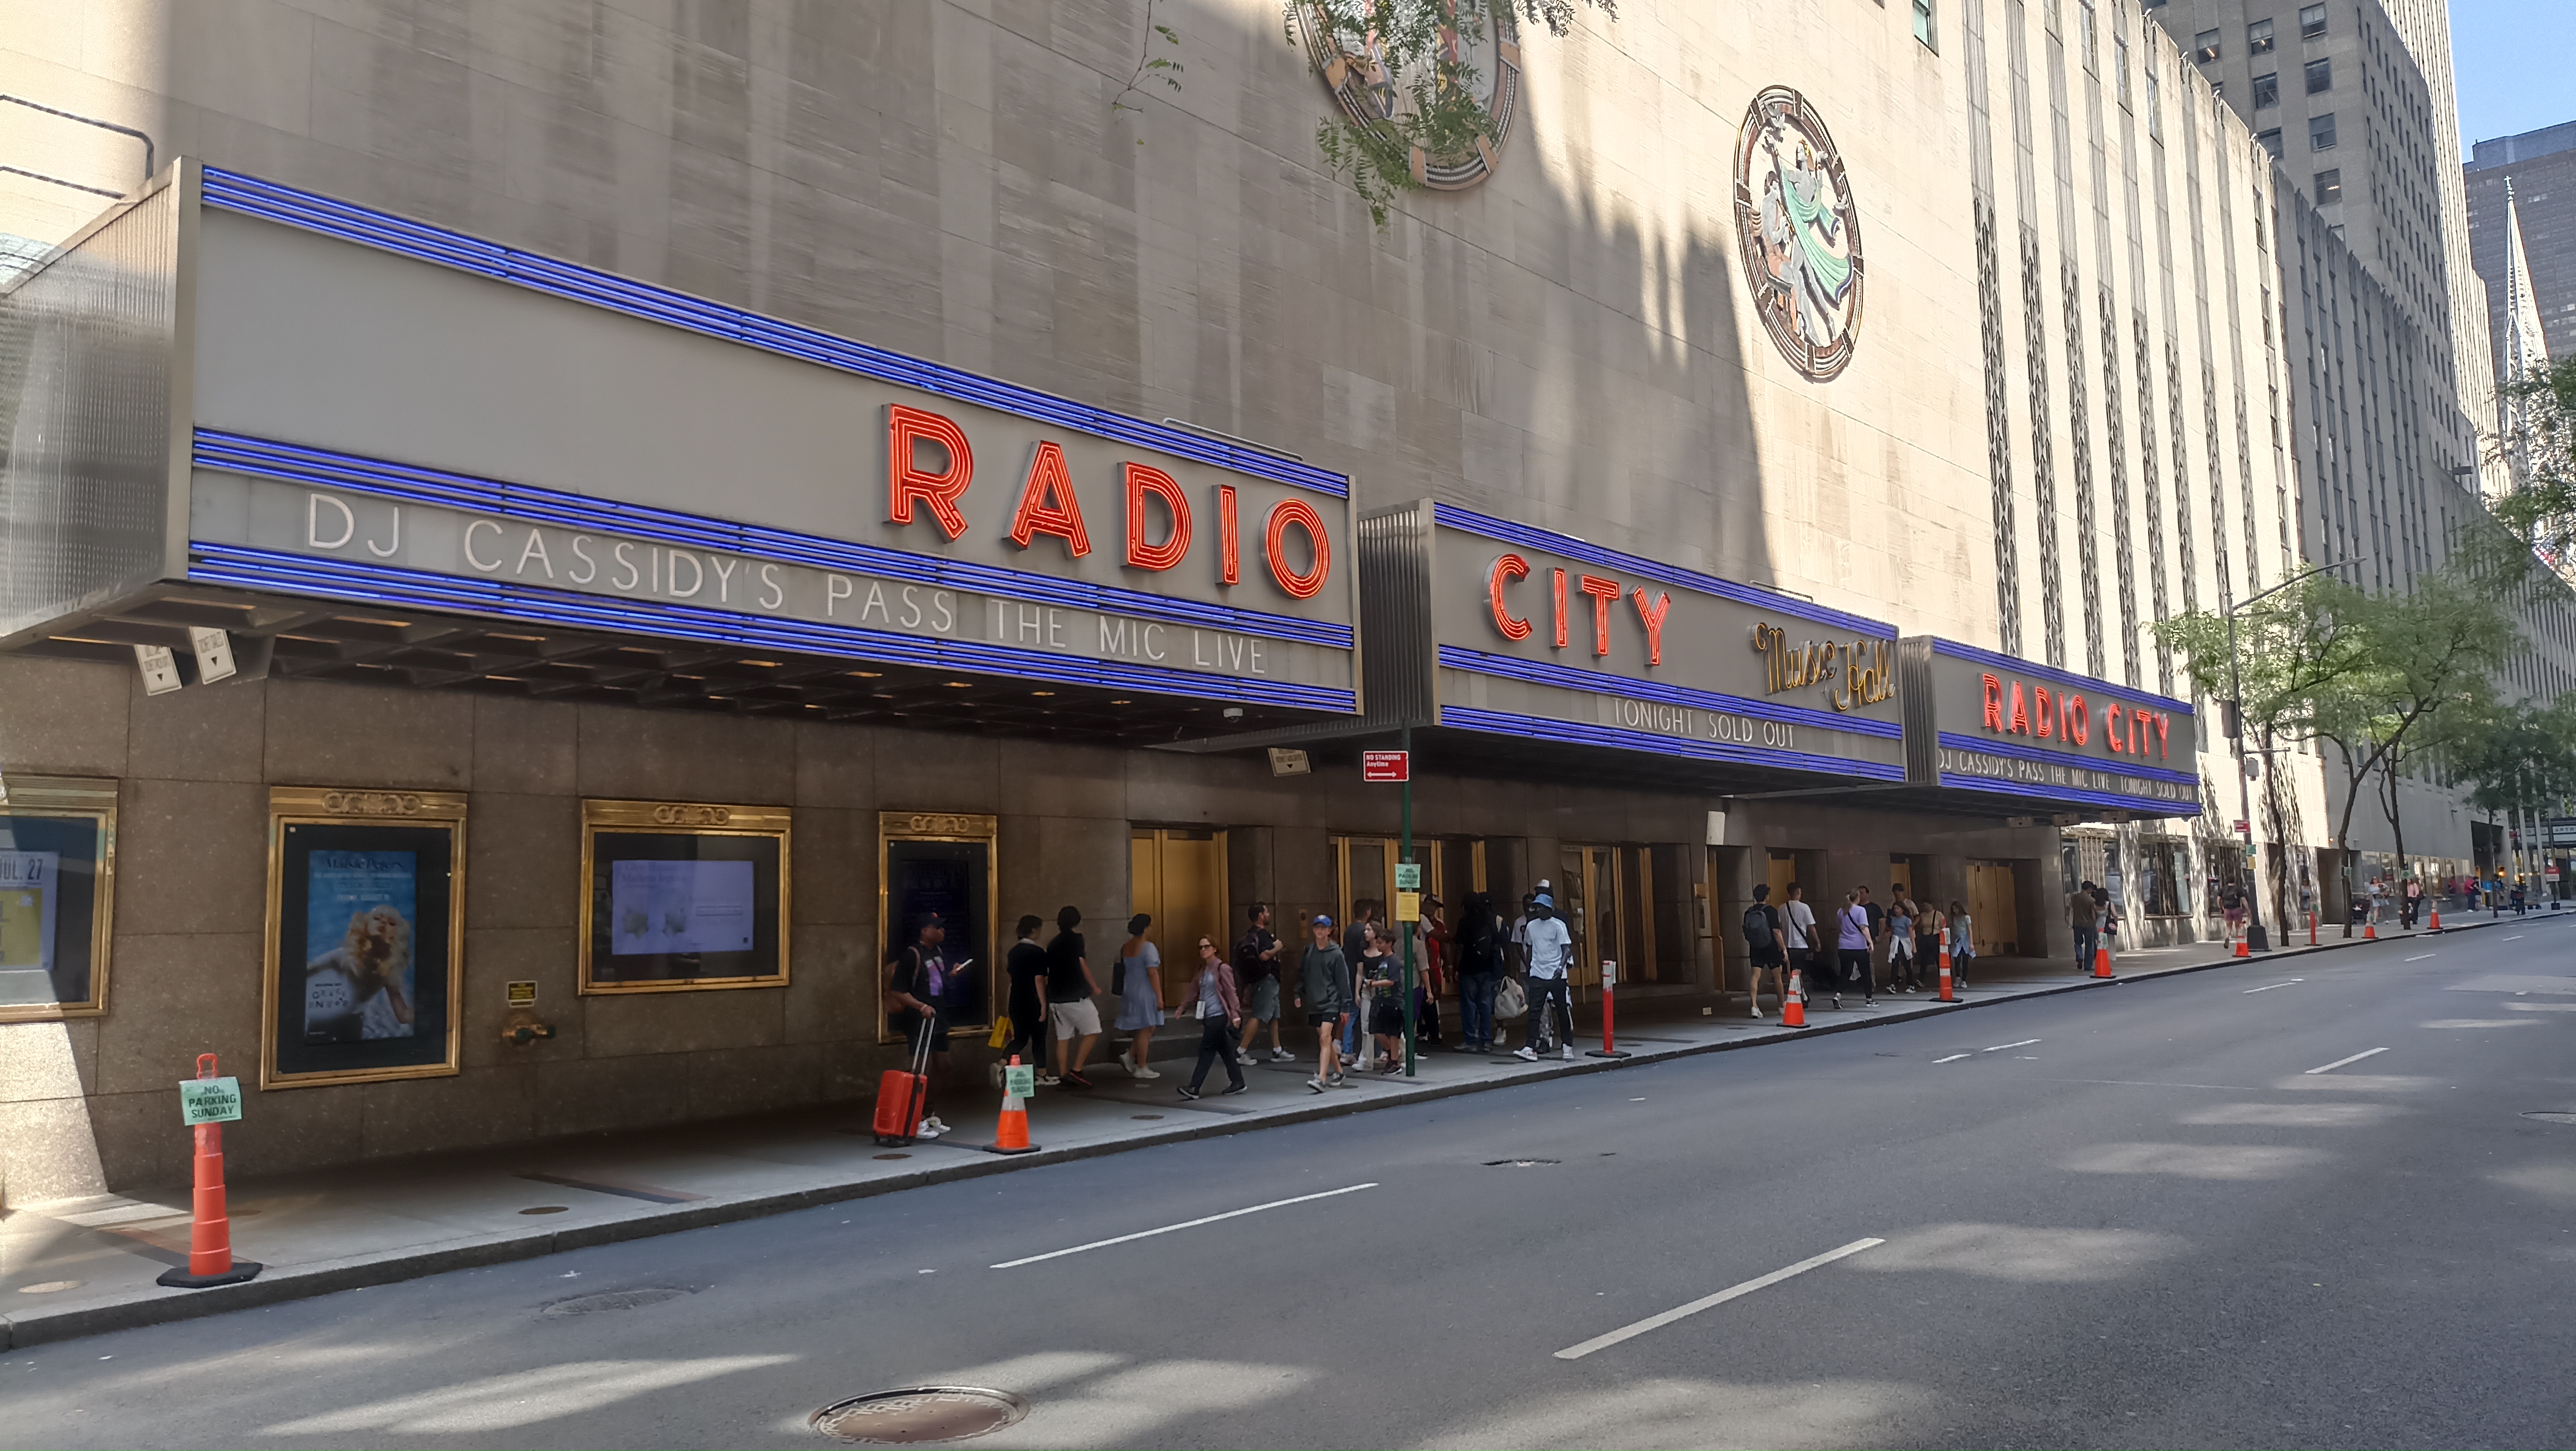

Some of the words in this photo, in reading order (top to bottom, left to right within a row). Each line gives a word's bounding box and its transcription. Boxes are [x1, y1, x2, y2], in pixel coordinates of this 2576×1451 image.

[885, 403, 1330, 600] RADIO
[309, 493, 400, 557] DJ
[464, 519, 783, 610] CASSIDY'S
[827, 573, 953, 633] PASS
[991, 599, 1066, 649] THE
[1100, 615, 1165, 661] MIC
[1194, 630, 1266, 674] LIVE
[1486, 553, 1671, 667] CITY
[1753, 622, 1837, 695] Music
[1832, 640, 1896, 712] Hall
[1612, 697, 1694, 735] TONIGHT
[1709, 714, 1753, 742] SOLD
[1763, 721, 1794, 748] OUT
[1982, 673, 2090, 746] RADIO
[2106, 703, 2169, 759] CITY
[1959, 751, 2013, 777] CASSIDY'S
[2018, 760, 2044, 781] PASS
[2050, 765, 2066, 785] THE
[2071, 769, 2087, 787] MIC
[2092, 772, 2110, 790] LIVE
[2120, 776, 2151, 795] TONIGHT
[2157, 782, 2176, 798] SOLD
[2179, 785, 2192, 800] OUT
[0, 859, 23, 880] UL.
[28, 859, 43, 880] 27
[188, 1094, 236, 1107] PARKING
[191, 1105, 234, 1118] SUNDAY
[204, 1085, 220, 1094] NO
